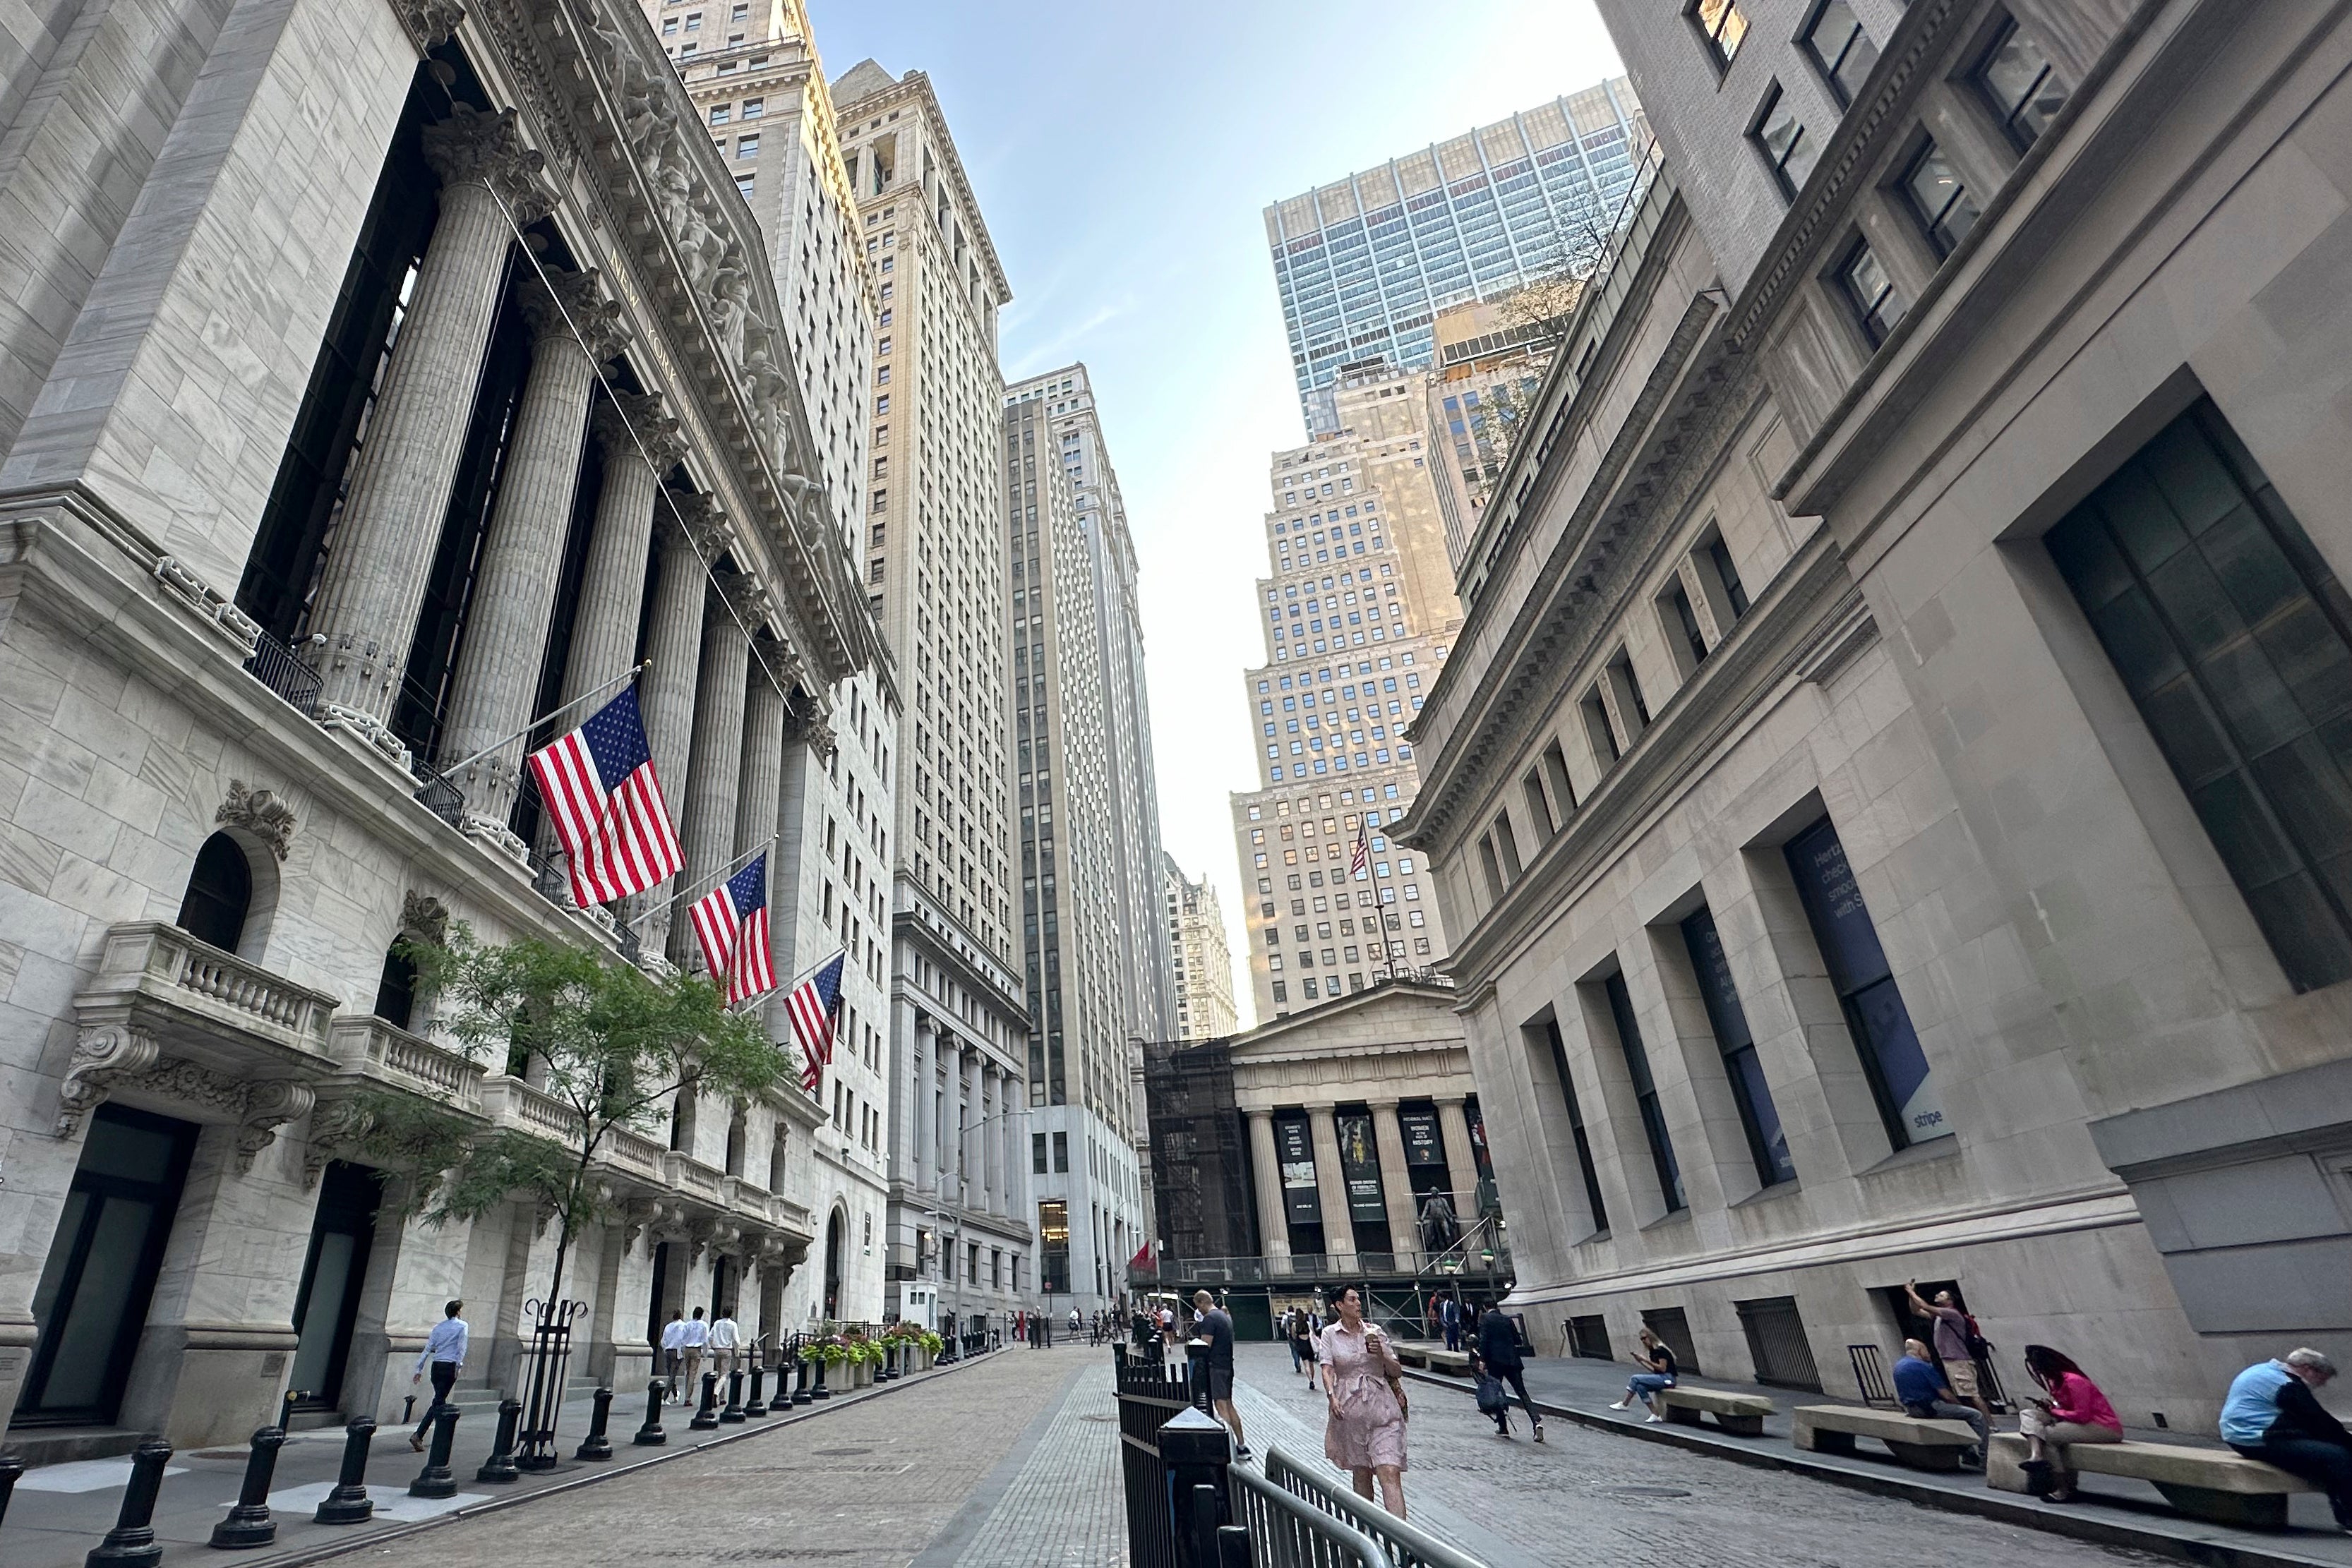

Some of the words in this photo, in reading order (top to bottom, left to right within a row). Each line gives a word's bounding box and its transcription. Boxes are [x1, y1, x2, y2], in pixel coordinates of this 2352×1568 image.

[609, 246, 640, 308] NEW
[647, 315, 677, 390] YORK
[682, 394, 713, 464] STOCK
[1814, 843, 1842, 868] Hertz
[1834, 900, 1856, 919] with
[1914, 1111, 1943, 1128] stripe
